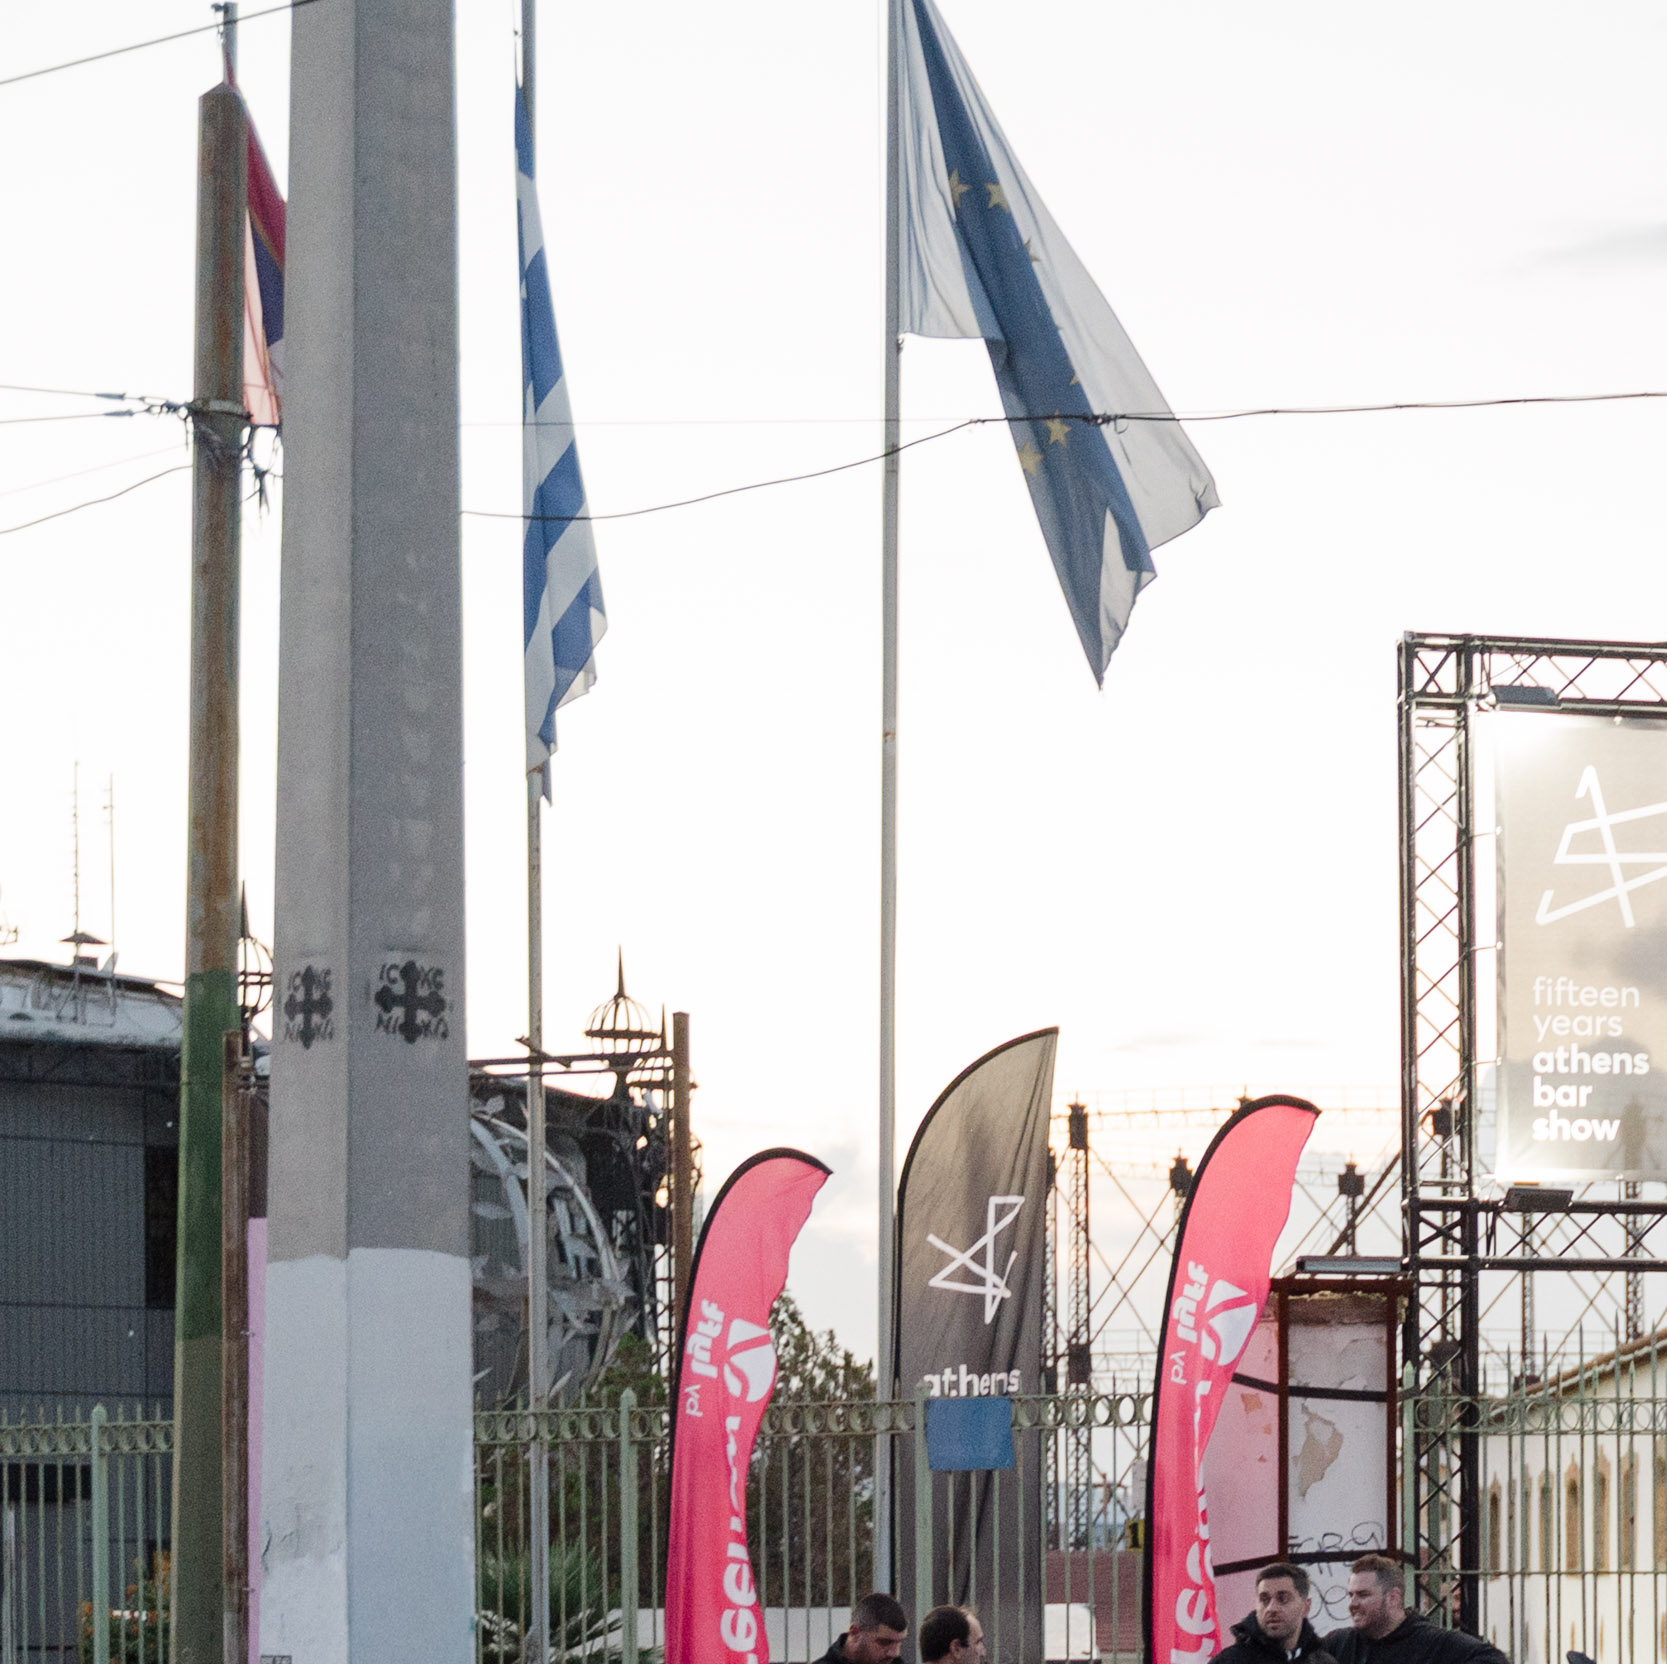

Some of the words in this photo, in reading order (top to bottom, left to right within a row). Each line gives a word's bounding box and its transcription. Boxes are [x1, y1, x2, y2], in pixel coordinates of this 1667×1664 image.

[1532, 976, 1641, 1008] fifteen
[1532, 1012, 1624, 1038] years
[1532, 1045, 1650, 1077] athens
[1532, 1076, 1593, 1109] bar
[1532, 1116, 1621, 1142] show
[922, 1363, 1022, 1397] athens
